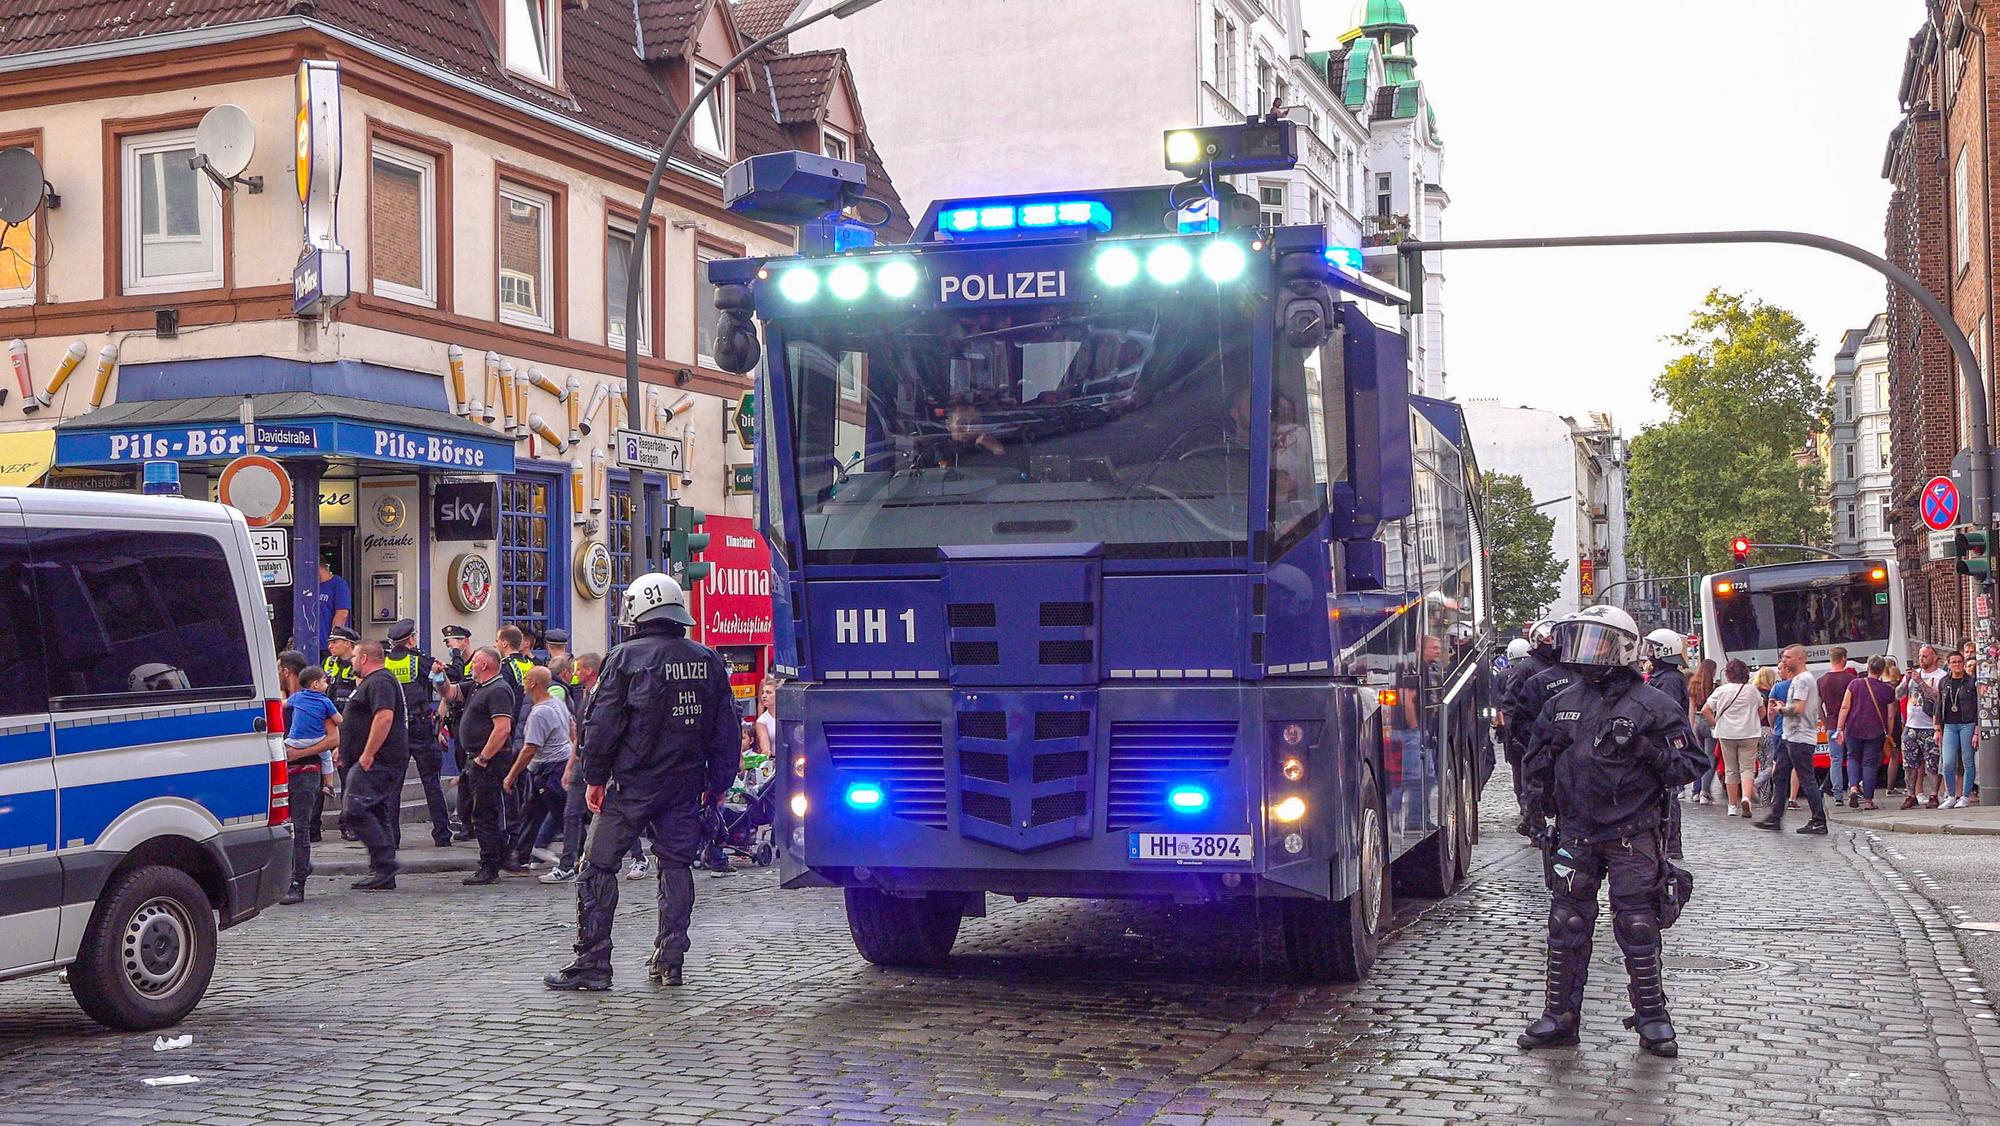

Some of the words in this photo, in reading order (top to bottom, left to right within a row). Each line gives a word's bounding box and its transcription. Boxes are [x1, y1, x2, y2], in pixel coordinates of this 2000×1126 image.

[940, 271, 1066, 302] POLIZEI
[110, 429, 279, 459] Pils-Bör
[257, 428, 310, 445] Davidstraße
[374, 430, 484, 467] Pils-Börse
[440, 497, 484, 527] sky
[364, 533, 415, 552] Getränke
[706, 562, 770, 596] Journa
[1731, 582, 1748, 590] 1724
[644, 585, 662, 600] 91
[836, 609, 887, 643] HH
[899, 608, 915, 643] 1
[1662, 647, 1674, 656] 91
[665, 662, 708, 680] POLIZEI
[1546, 678, 1569, 690] POLIZEI
[678, 691, 697, 704] HH
[1555, 711, 1581, 721] POLIZEI
[1150, 836, 1177, 856] HH
[1191, 837, 1240, 857] 3894
